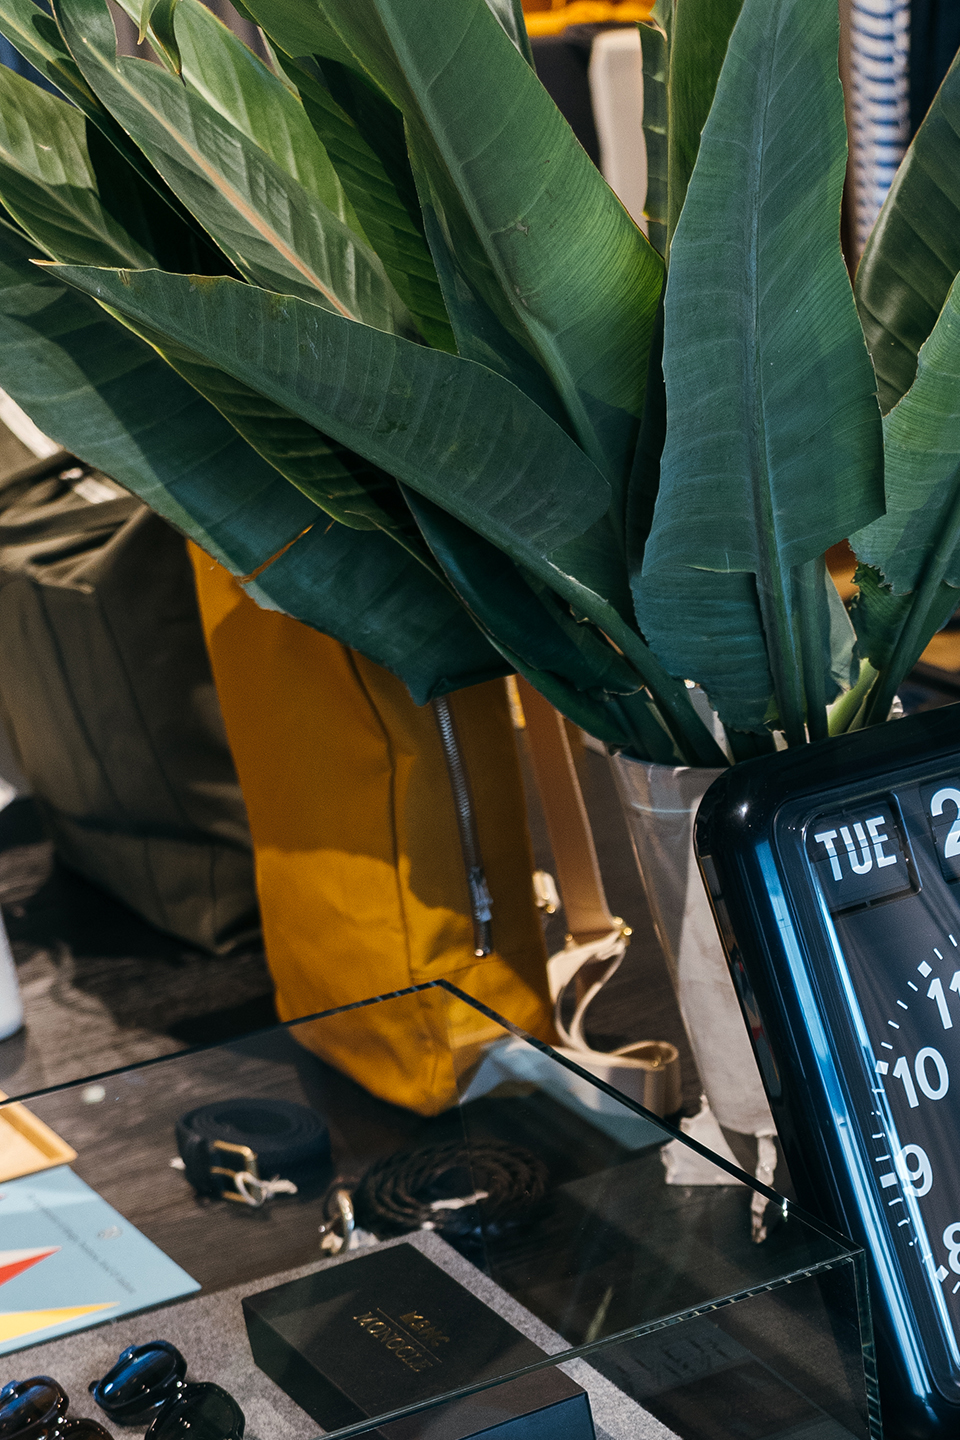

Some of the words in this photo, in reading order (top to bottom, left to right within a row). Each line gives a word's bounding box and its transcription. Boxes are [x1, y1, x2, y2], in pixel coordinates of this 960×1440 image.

[814, 816, 897, 883] TUE
[892, 1046, 949, 1109] 10
[900, 1143, 933, 1198] 9
[353, 1311, 433, 1372] MONOCLE
